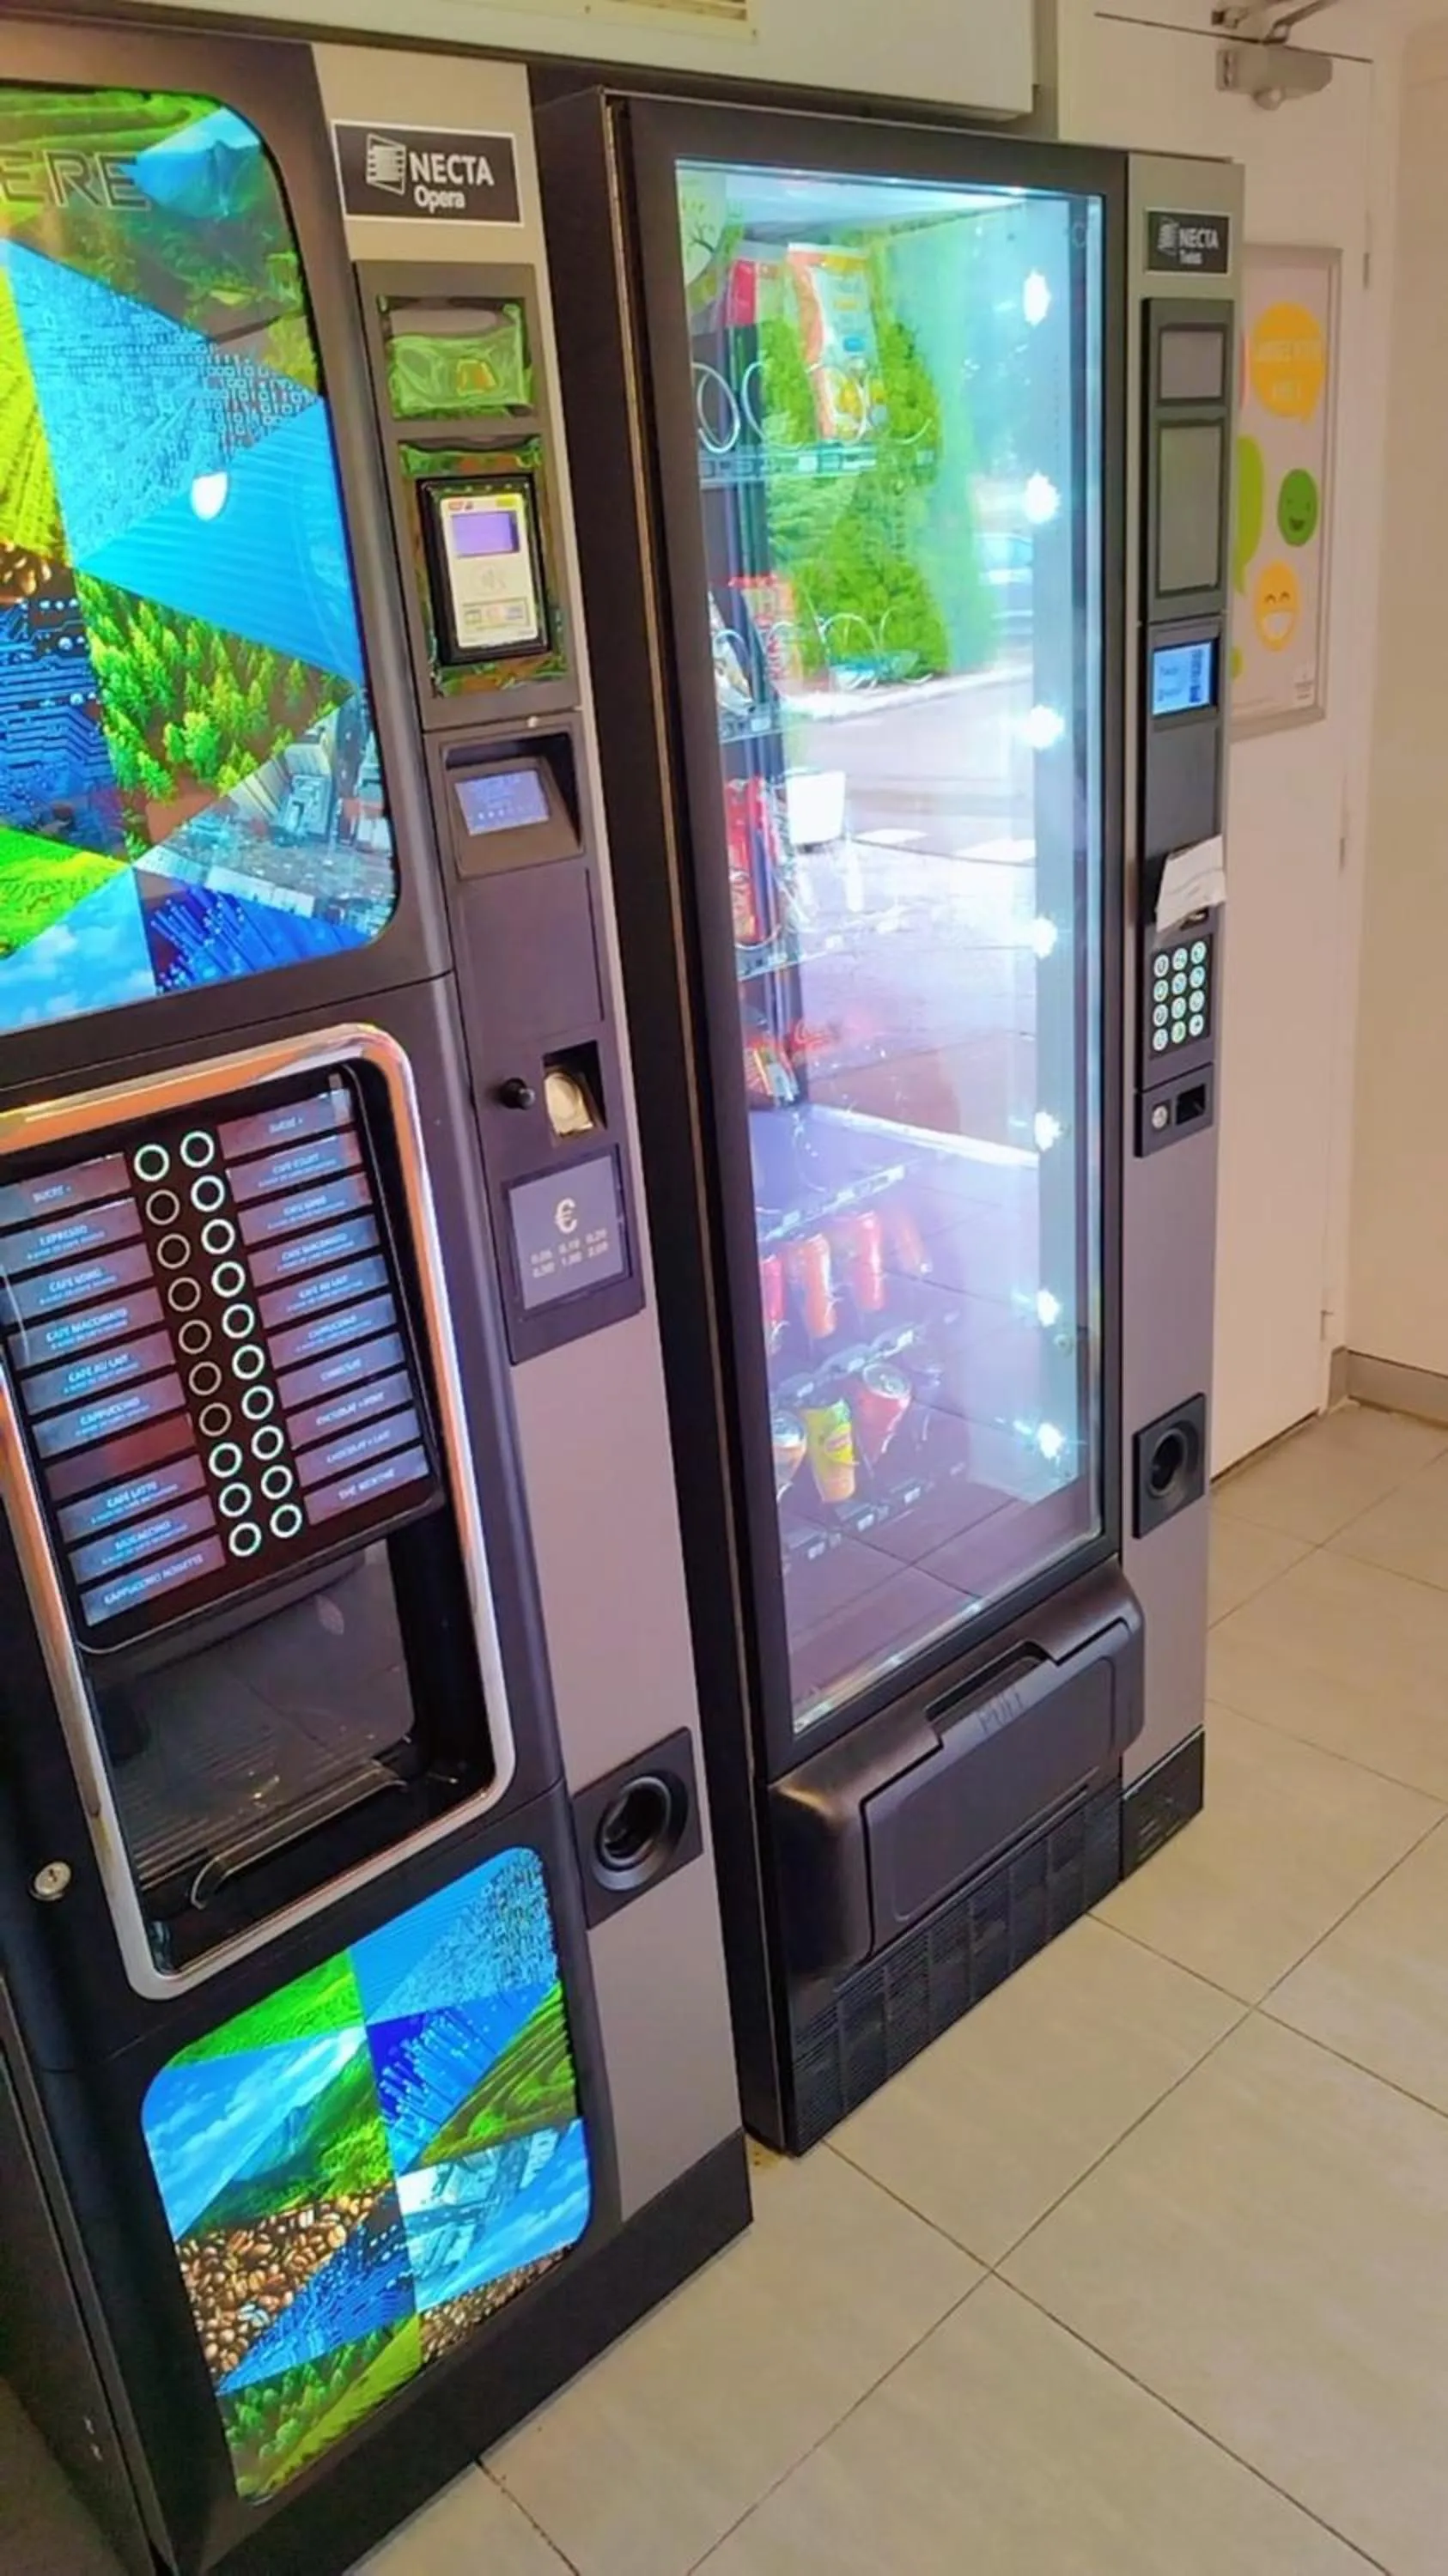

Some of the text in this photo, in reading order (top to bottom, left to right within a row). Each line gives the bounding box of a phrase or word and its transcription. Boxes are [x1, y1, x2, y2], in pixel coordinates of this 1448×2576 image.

[409, 151, 495, 186] NECTA
[414, 185, 465, 214] Opera
[1179, 228, 1219, 249] NECTA
[554, 1197, 578, 1234] €
